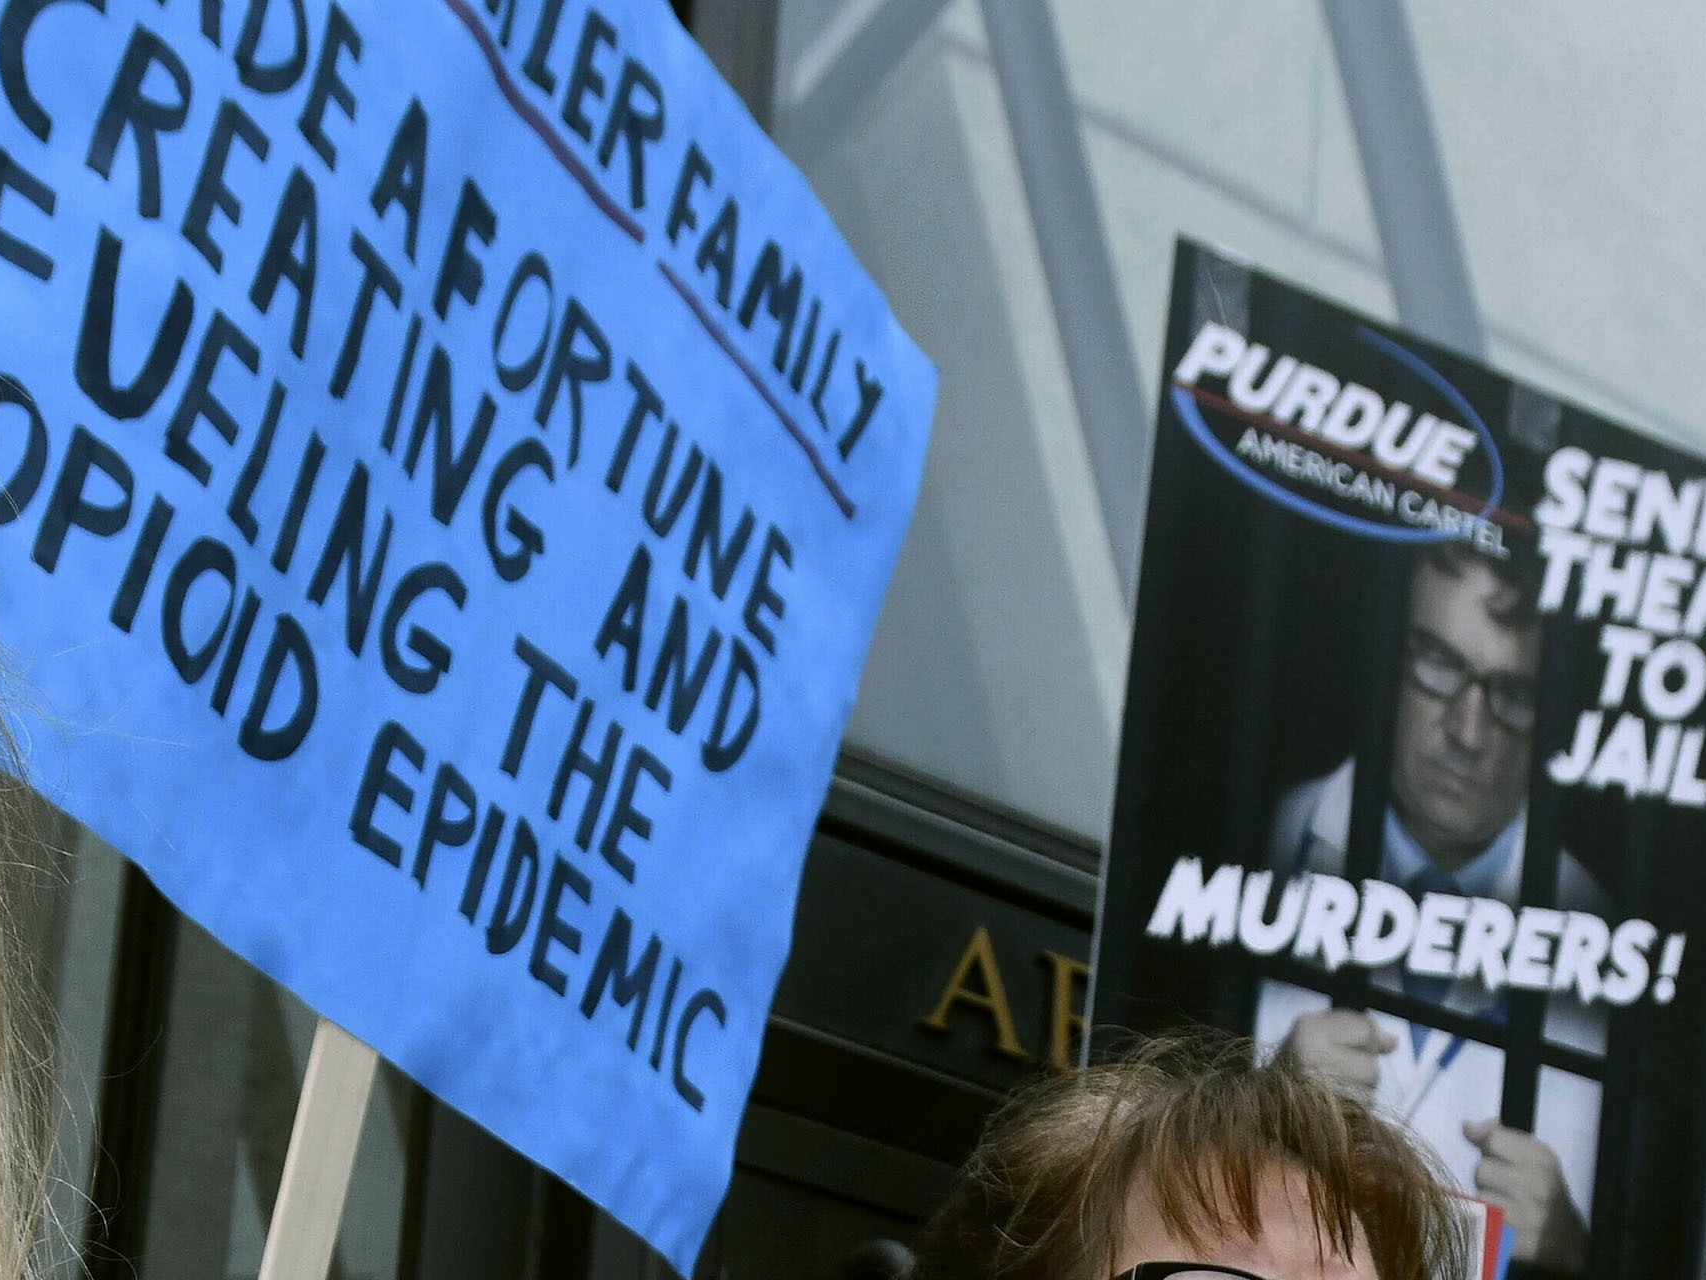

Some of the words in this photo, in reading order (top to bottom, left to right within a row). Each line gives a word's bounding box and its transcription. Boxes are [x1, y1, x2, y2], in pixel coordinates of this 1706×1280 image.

[195, 0, 363, 173] DE
[370, 94, 430, 259] A
[434, 176, 794, 659] FORTUNE
[486, 0, 667, 210] LER
[666, 138, 887, 462] FAMILY
[1175, 320, 1477, 488] PURDUE
[1235, 426, 1397, 513] AMERICAN
[1397, 488, 1511, 559] CARTEL
[500, 635, 674, 884] THE
[596, 542, 764, 774] AND
[348, 719, 730, 1113] EPIDEMIC
[1146, 856, 1687, 1006] MURDERERS!
